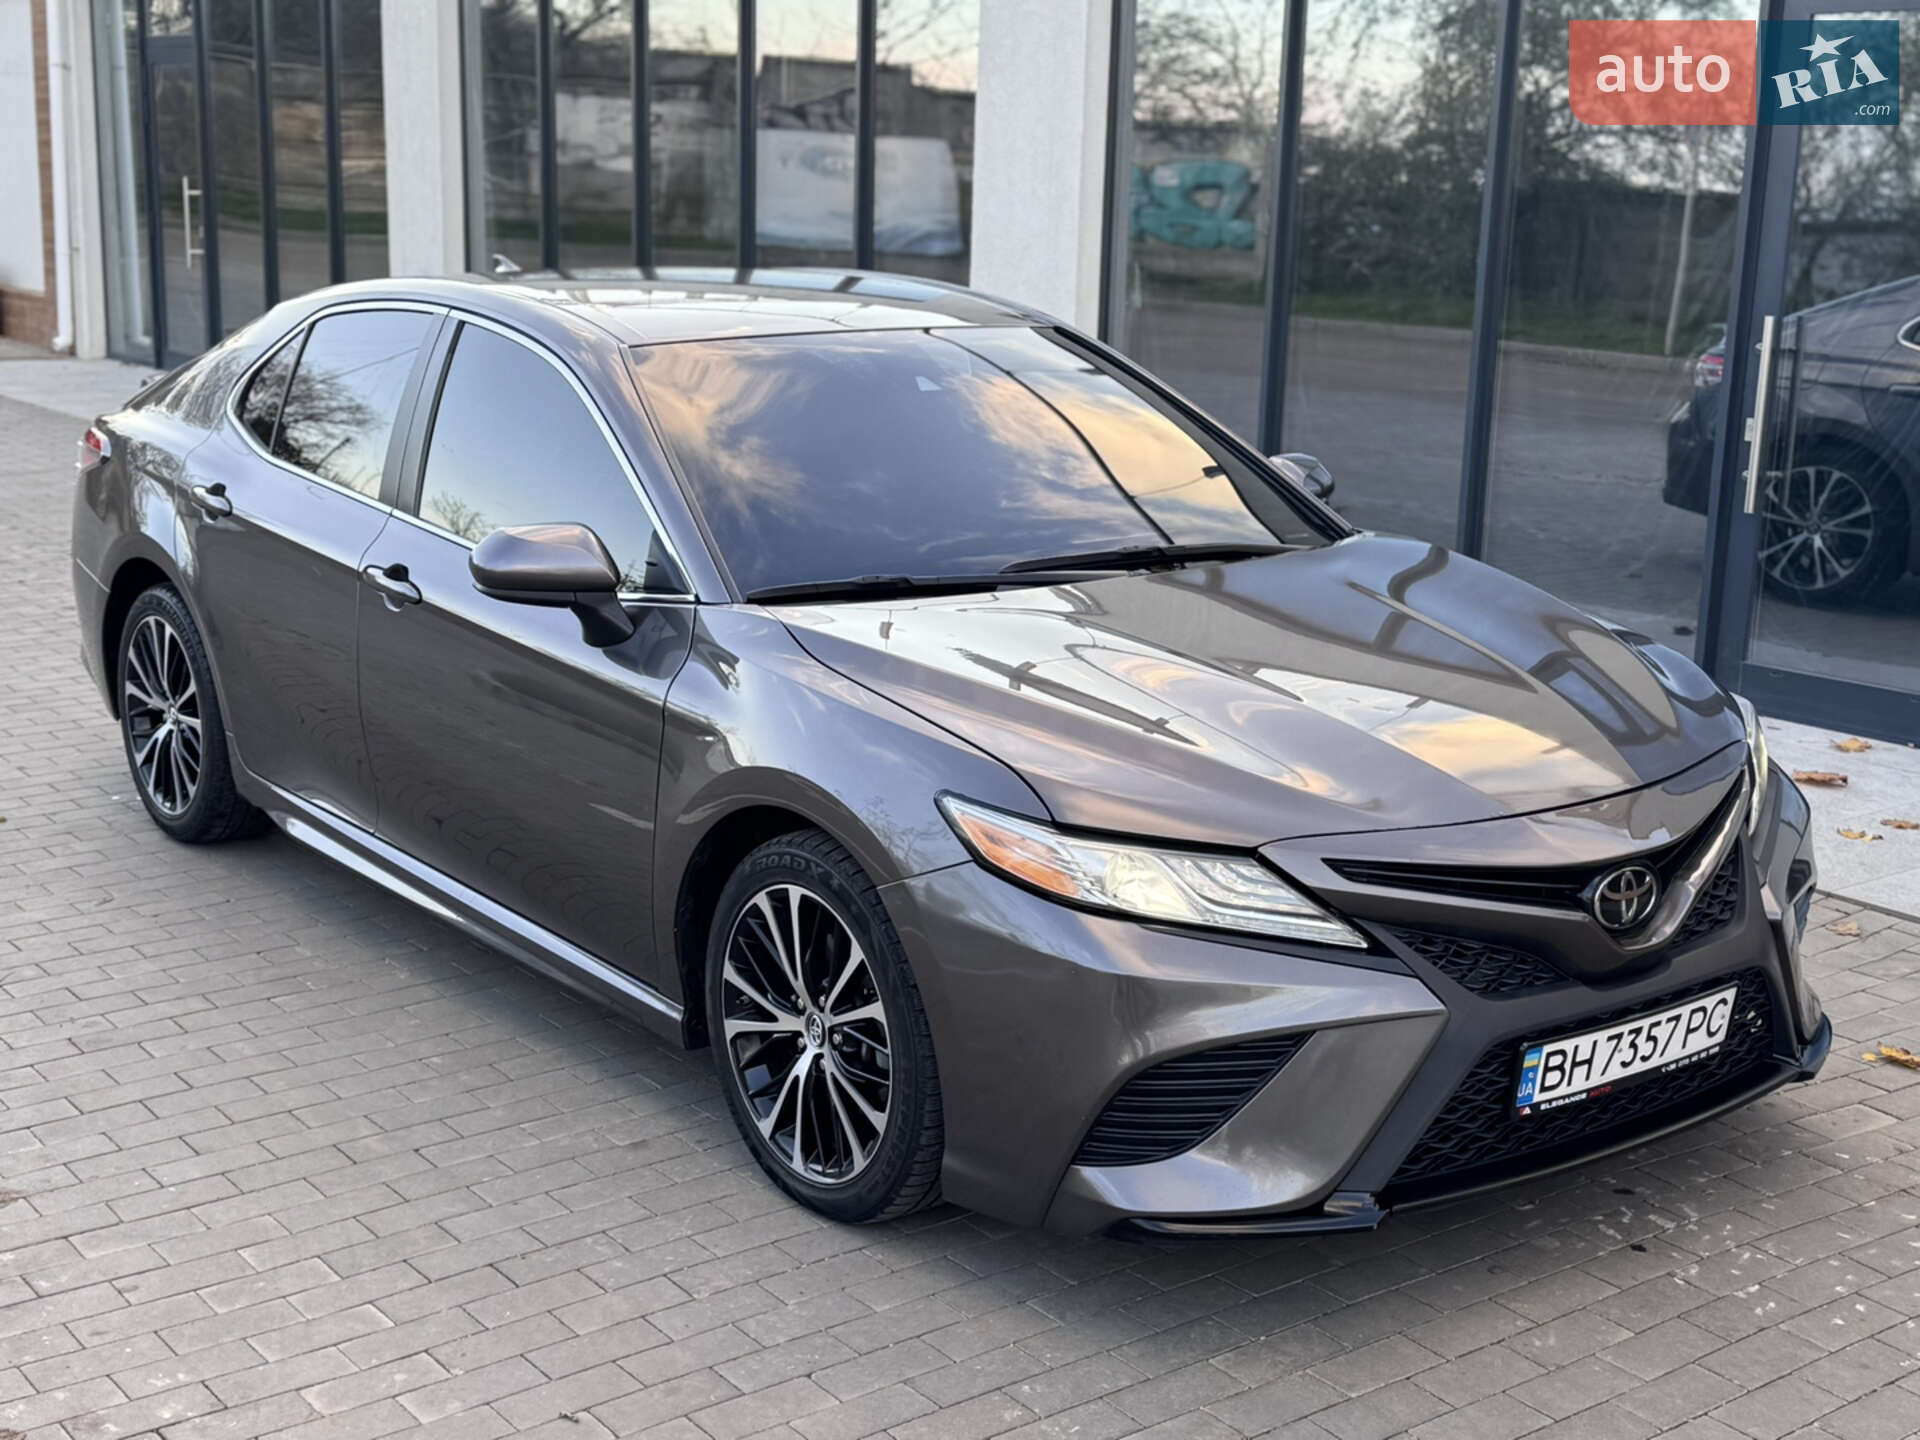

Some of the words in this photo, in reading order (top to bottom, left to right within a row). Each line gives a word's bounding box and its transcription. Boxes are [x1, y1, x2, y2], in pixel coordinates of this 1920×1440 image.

[1538, 1038, 1599, 1095] BH
[1600, 1013, 1683, 1077] 7357
[1682, 997, 1729, 1050] PC
[1517, 1081, 1535, 1098] UA
